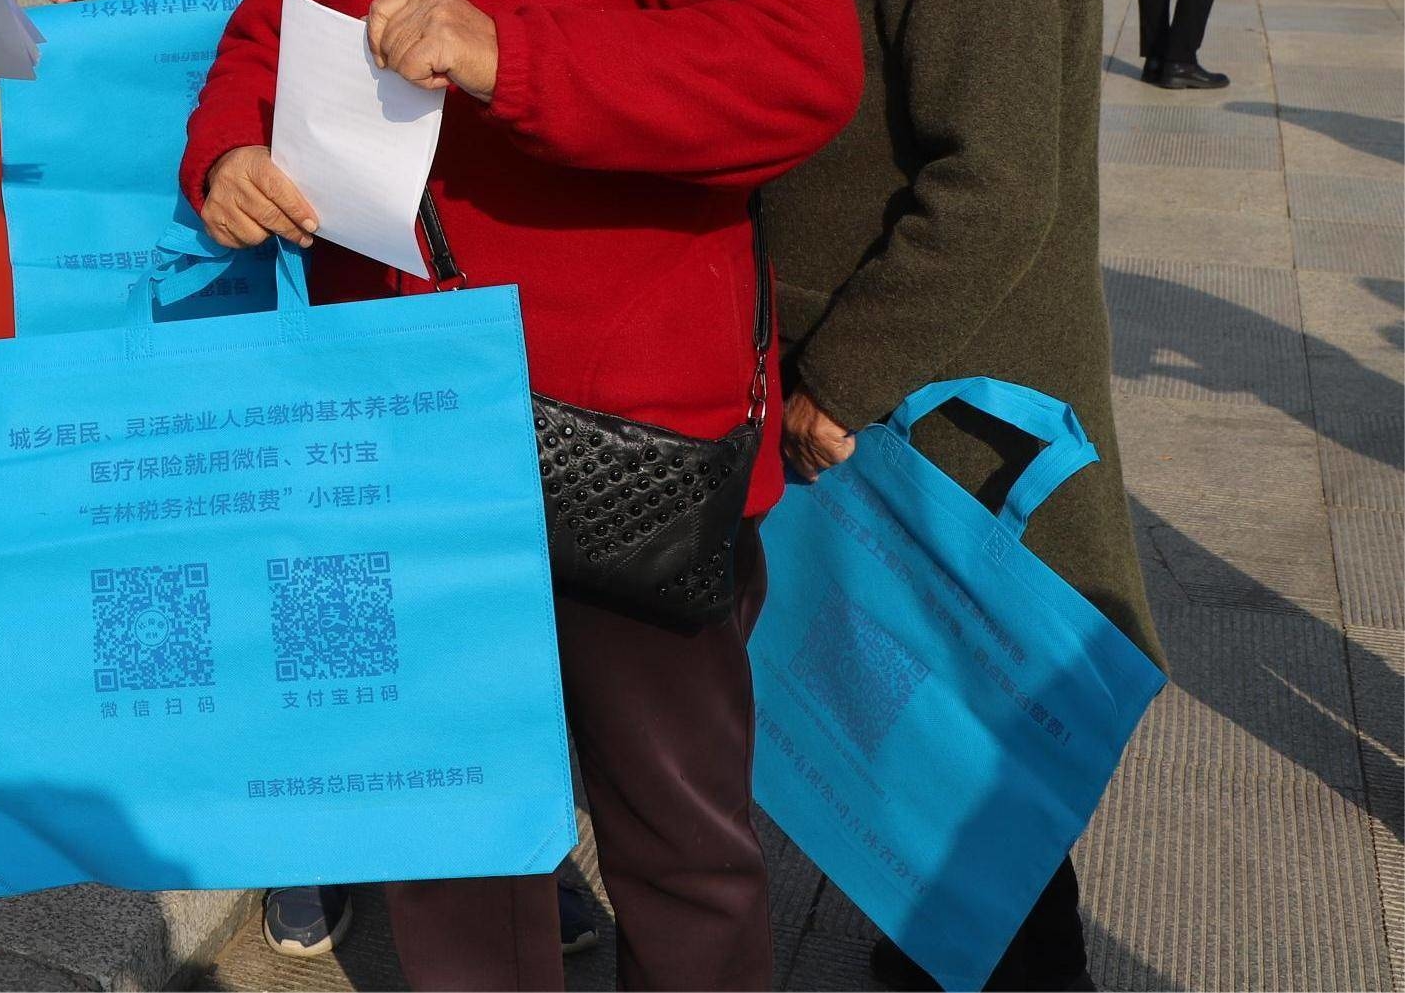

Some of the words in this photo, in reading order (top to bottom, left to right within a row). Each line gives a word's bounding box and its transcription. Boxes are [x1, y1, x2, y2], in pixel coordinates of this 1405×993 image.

[8, 389, 459, 450] 城乡居民、灵活就业人员缴纳基本养老保险
[90, 441, 379, 484] 医疗保险就用微信、支付宝
[100, 696, 215, 719] 微信扫码
[282, 684, 398, 709] 支付宝扫码
[247, 766, 484, 799] 国家税务总局吉林省税务局
